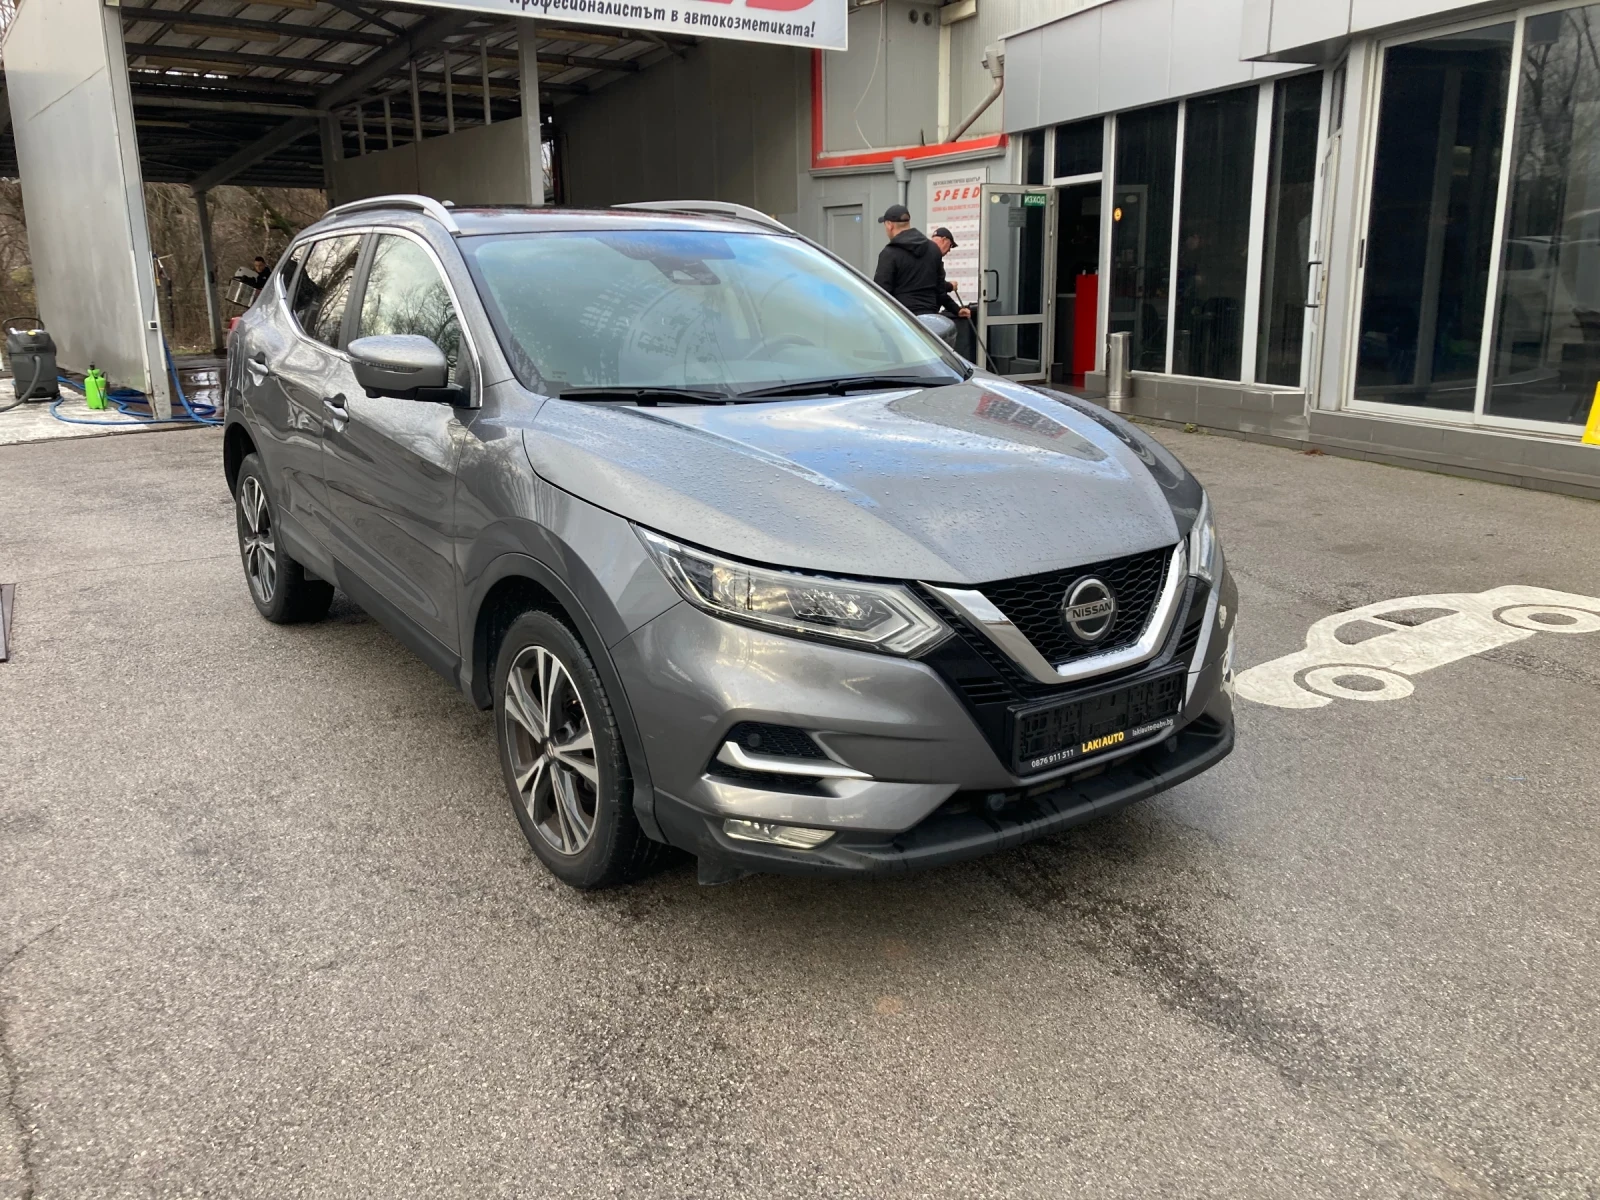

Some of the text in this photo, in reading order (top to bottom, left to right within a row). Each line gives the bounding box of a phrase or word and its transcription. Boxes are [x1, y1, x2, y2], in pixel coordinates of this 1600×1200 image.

[671, 10, 678, 22] в
[684, 11, 816, 38] автокозметиката!
[933, 186, 980, 202] SPEED
[1024, 195, 1045, 205] ИЗХОД
[1072, 602, 1111, 618] NISSAN
[1031, 757, 1048, 768] 0876
[1049, 753, 1061, 763] 911
[1062, 749, 1074, 759] 511
